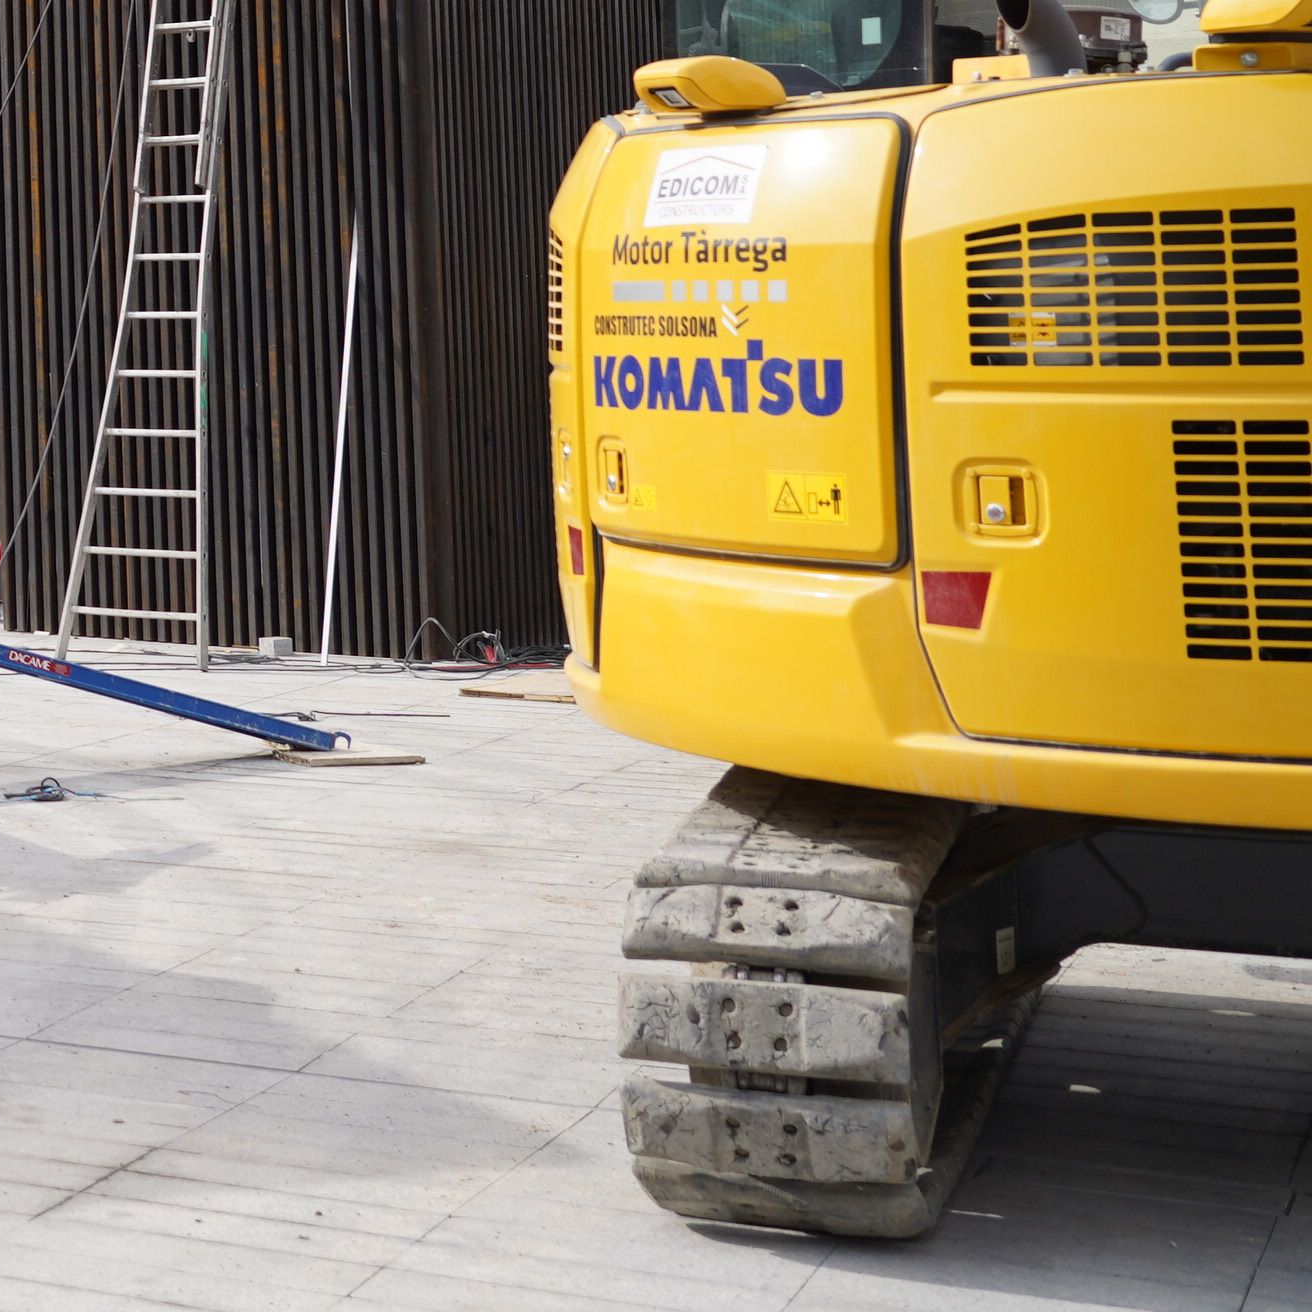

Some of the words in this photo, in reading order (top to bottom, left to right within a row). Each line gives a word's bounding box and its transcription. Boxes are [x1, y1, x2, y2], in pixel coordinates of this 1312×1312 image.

[657, 174, 739, 199] EDICOM
[613, 235, 673, 265] Motor
[681, 229, 787, 272] Tàrrega
[594, 315, 655, 336] CONSTRUTEC
[659, 316, 717, 338] SOLSONA
[594, 339, 843, 417] KOMATSU
[9, 650, 52, 672] DACAME
